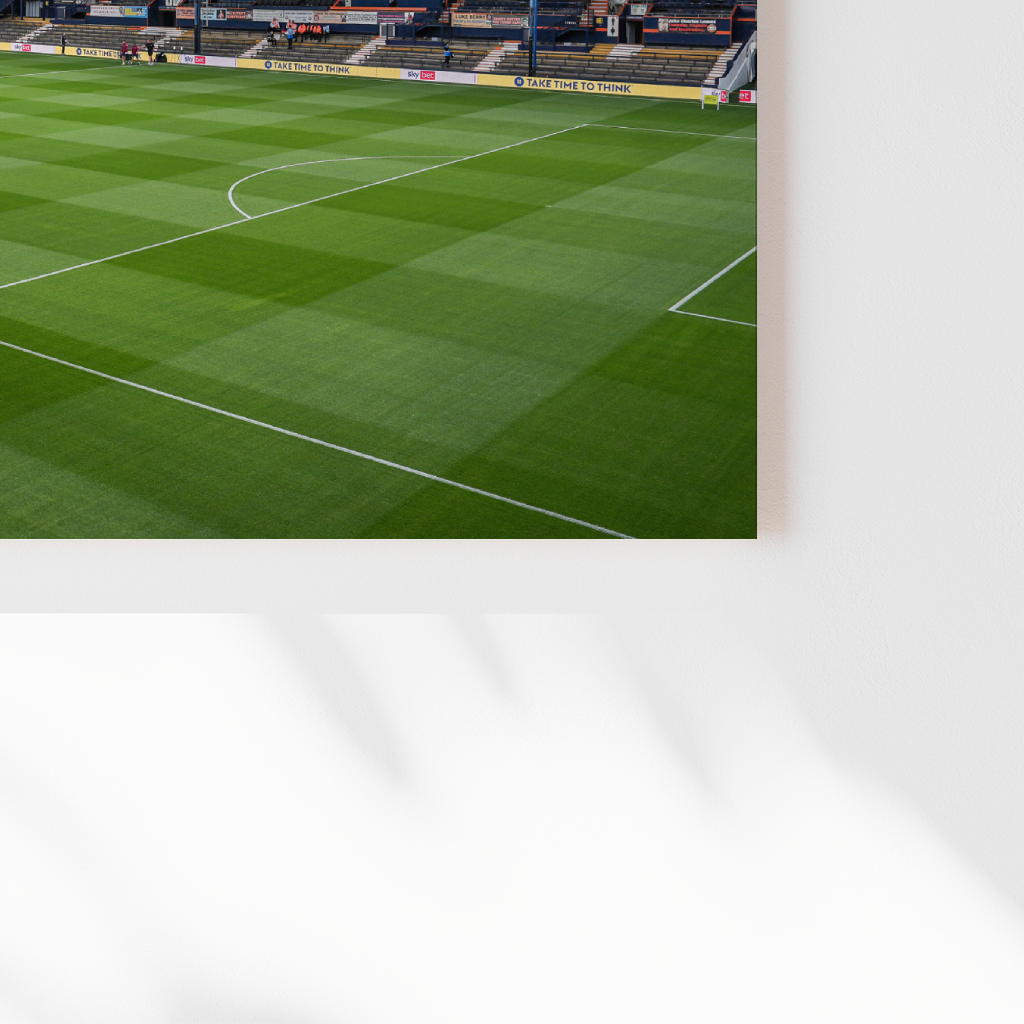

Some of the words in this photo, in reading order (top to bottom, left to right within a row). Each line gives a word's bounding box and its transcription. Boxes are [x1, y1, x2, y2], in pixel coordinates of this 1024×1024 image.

[83, 48, 97, 56] TAKE
[98, 49, 112, 57] TIME
[273, 61, 293, 70] TAKE
[294, 62, 312, 71] TIME
[313, 64, 324, 72] TO
[326, 65, 350, 74] THINK
[408, 71, 419, 80] sky
[526, 78, 552, 88] TAKE
[554, 80, 578, 90] TIME
[581, 81, 595, 91] TO
[597, 83, 631, 93] THINK
